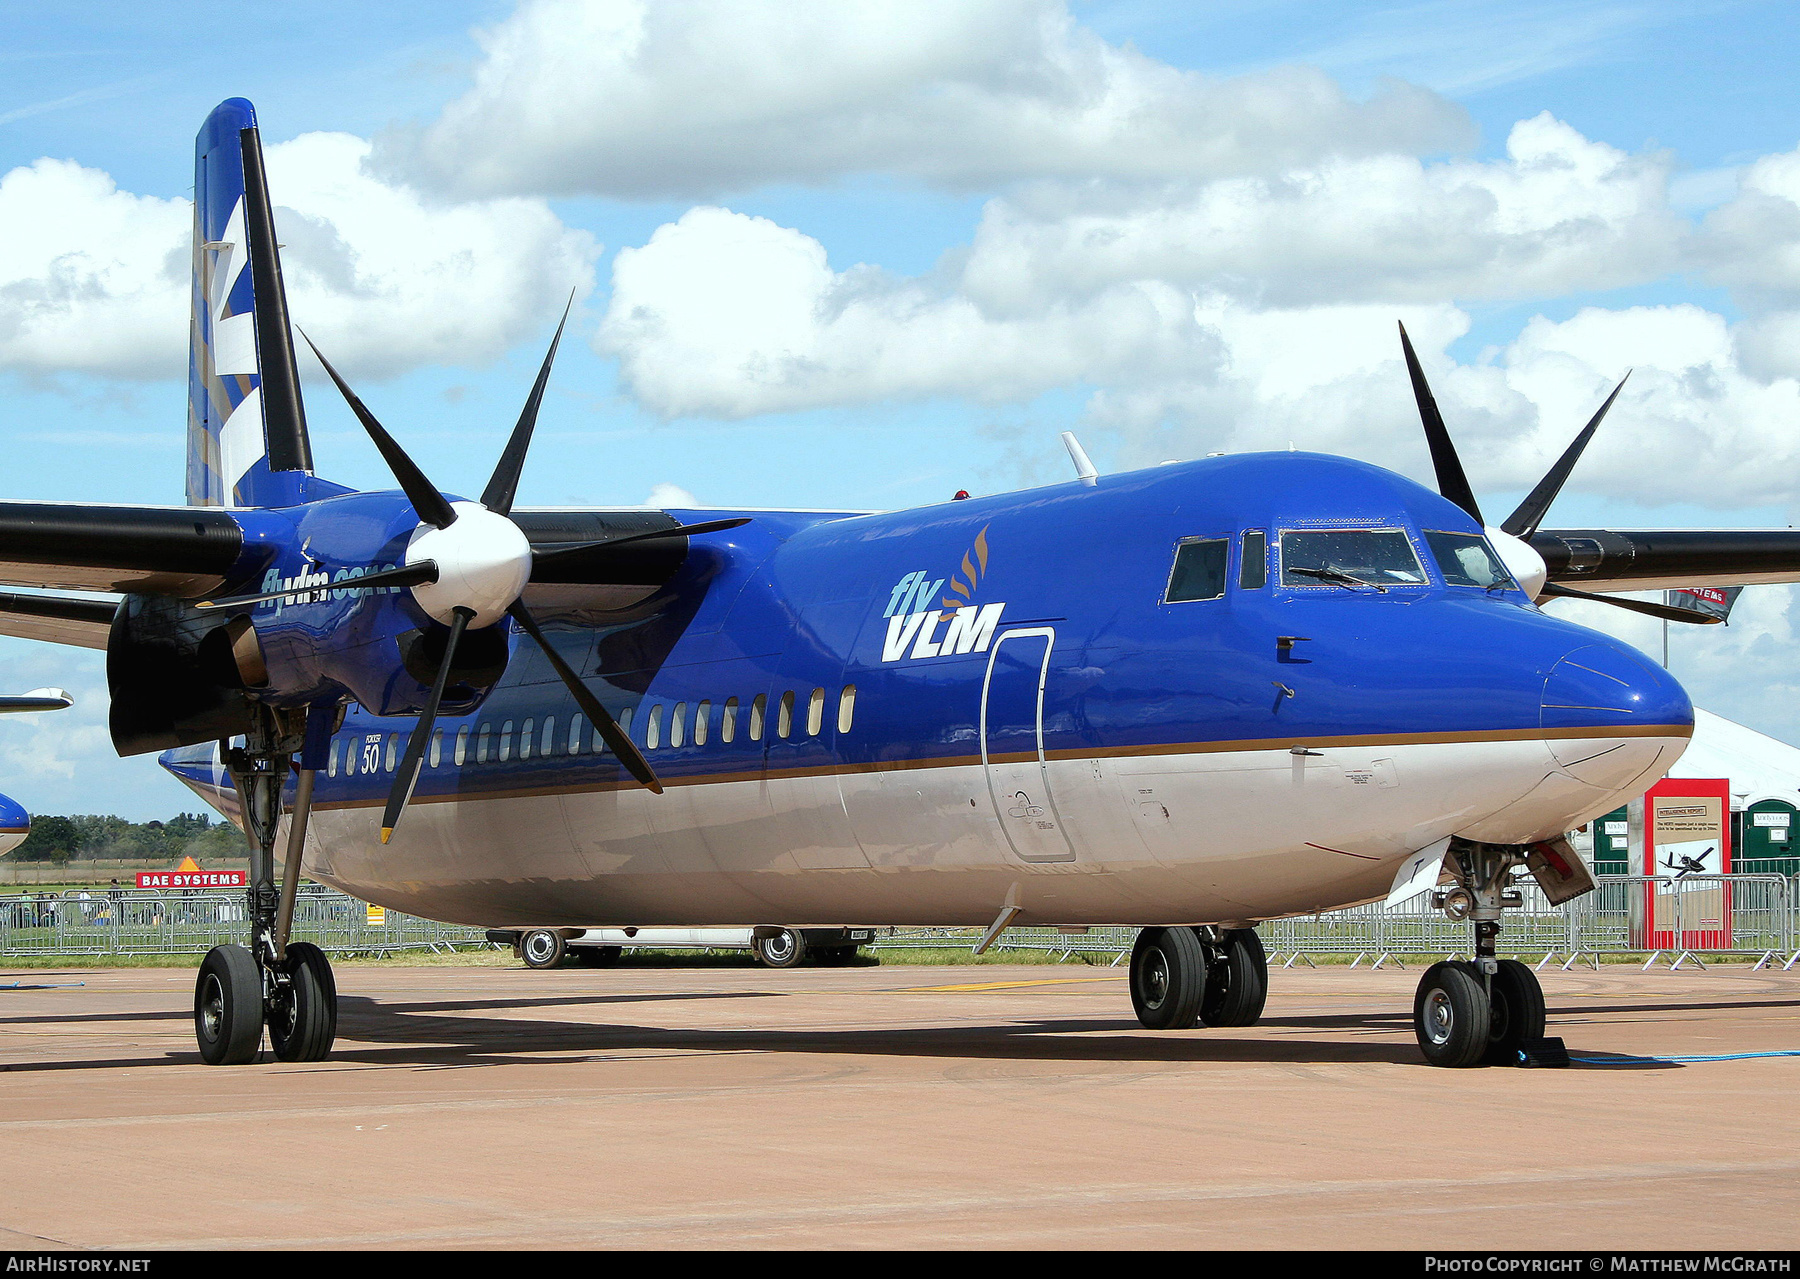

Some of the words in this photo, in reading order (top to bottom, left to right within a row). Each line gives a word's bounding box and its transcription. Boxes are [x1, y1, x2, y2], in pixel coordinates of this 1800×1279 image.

[883, 570, 945, 626] fly
[1693, 588, 1723, 601] STEMS
[881, 602, 1006, 662] VLM
[361, 744, 379, 774] 50
[142, 875, 169, 886] BAE
[173, 874, 240, 886] SYSTEMS
[1410, 857, 1425, 883] T
